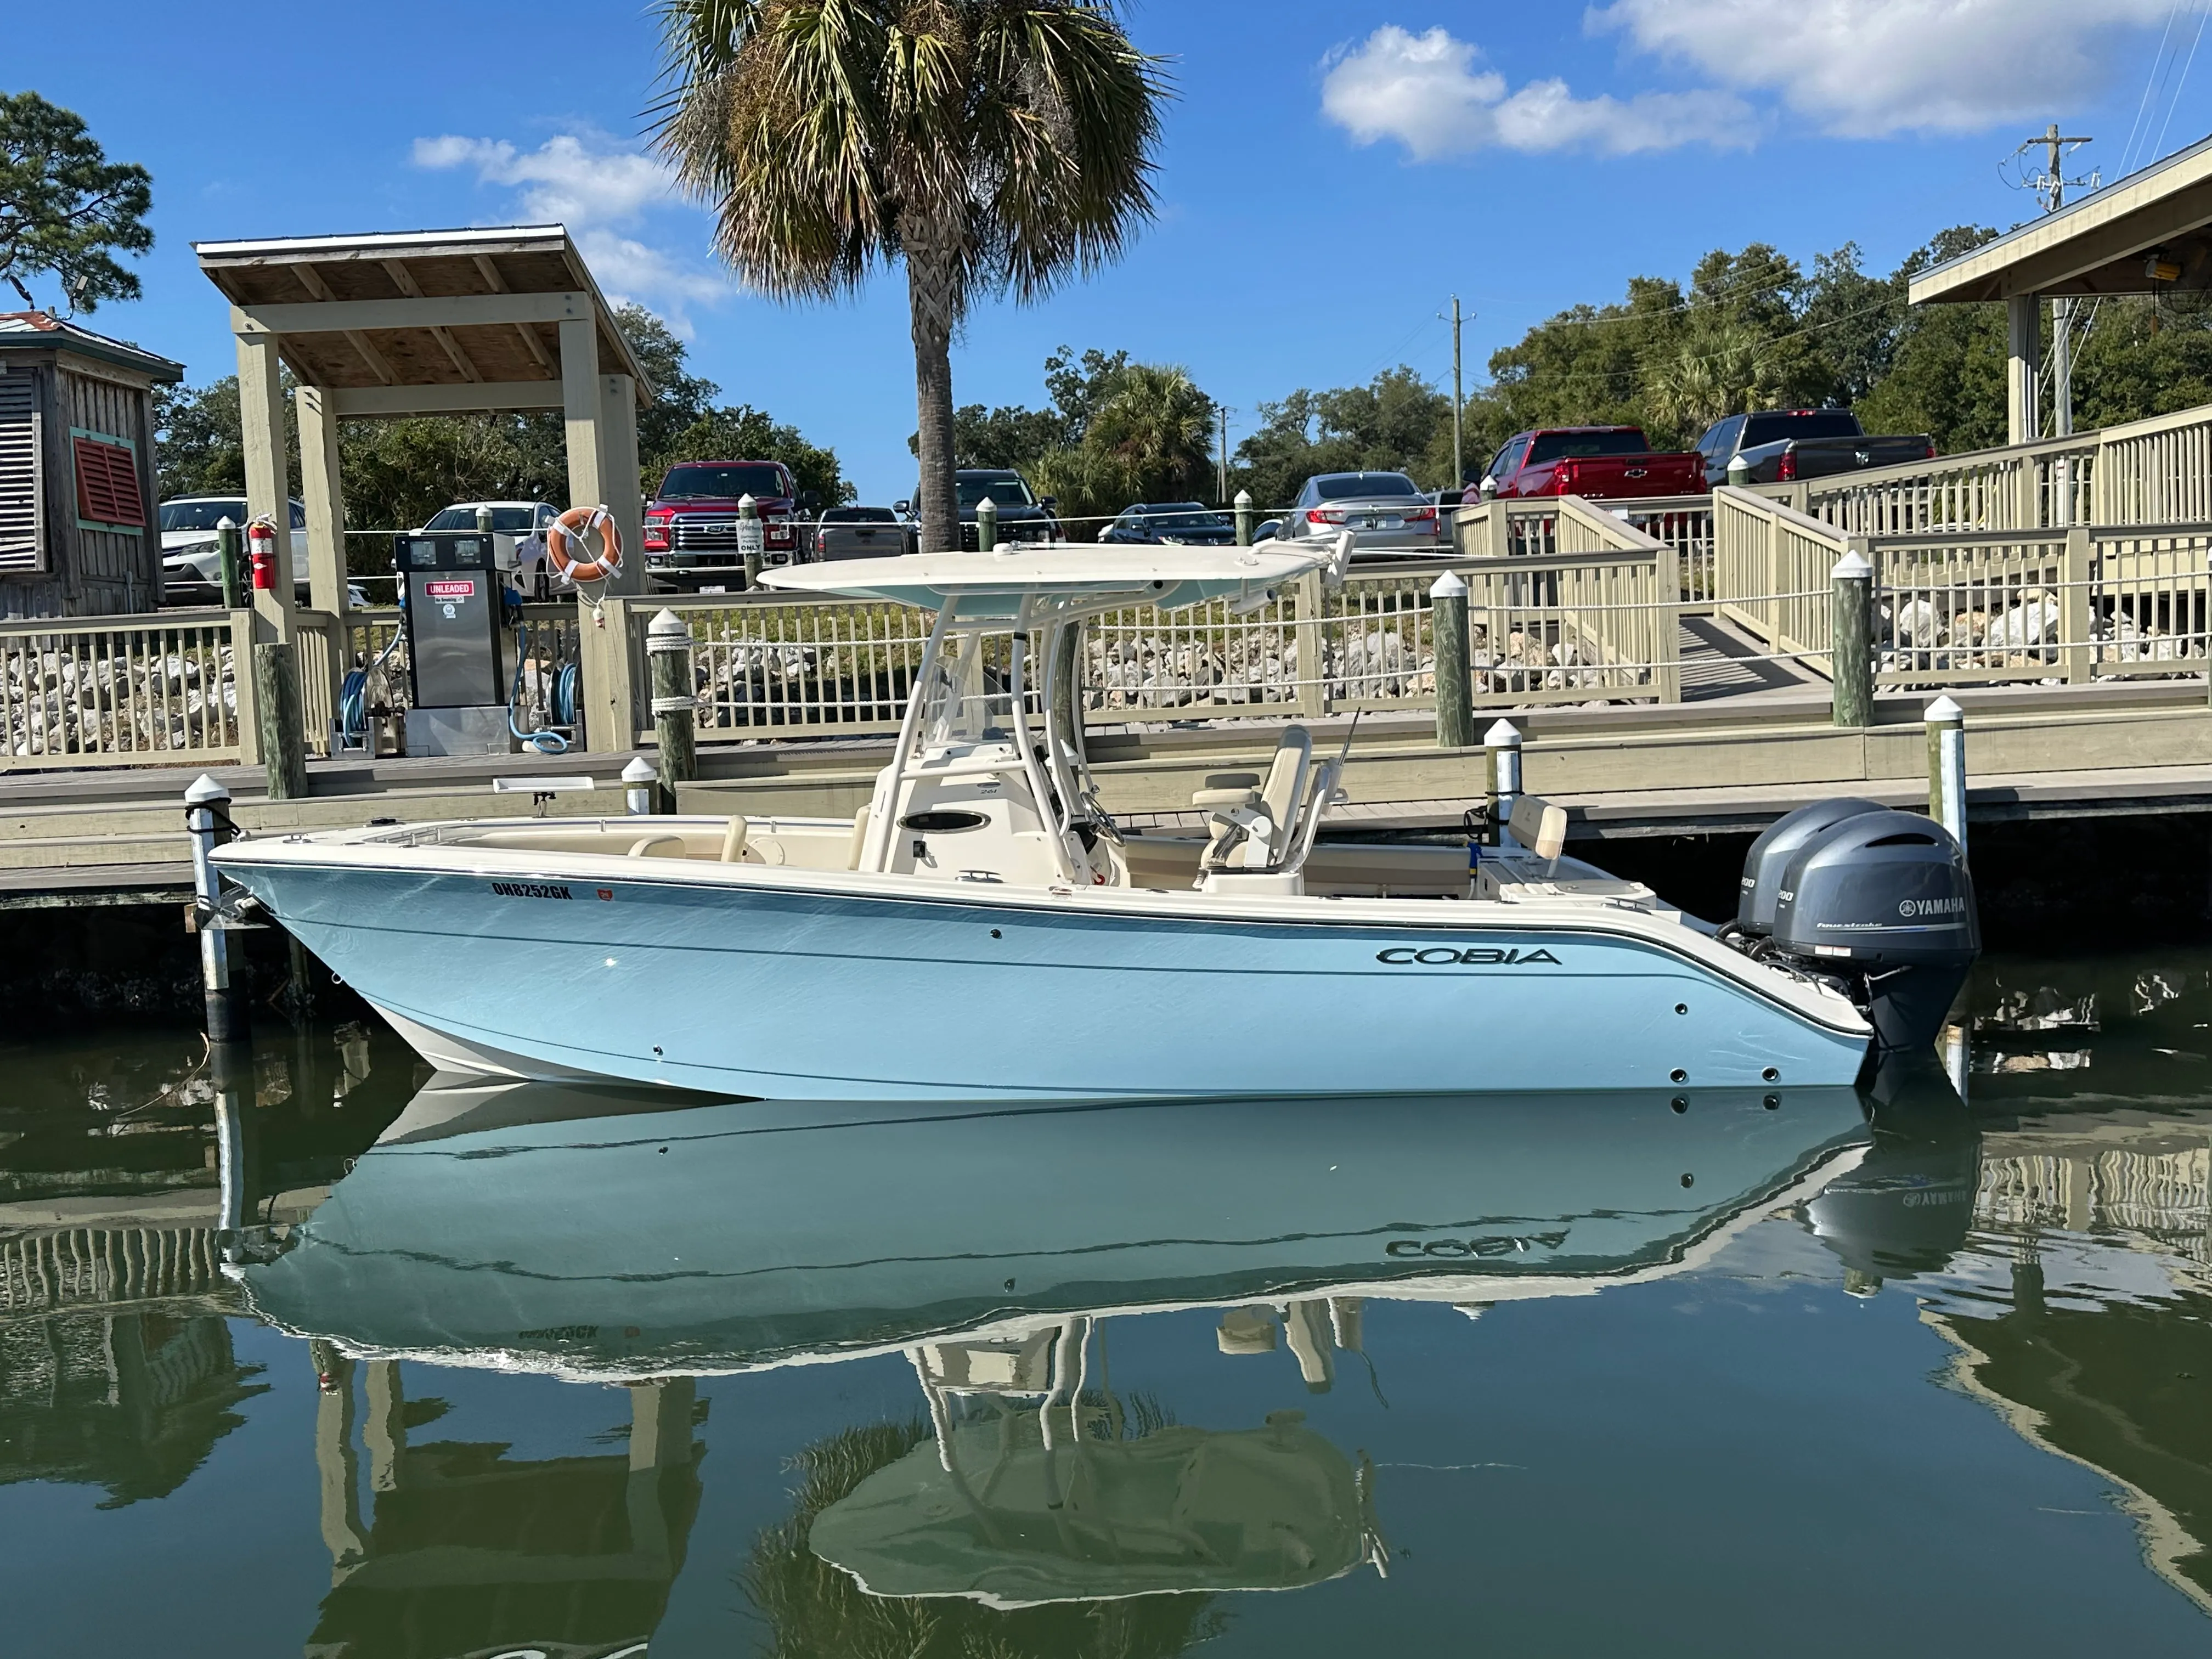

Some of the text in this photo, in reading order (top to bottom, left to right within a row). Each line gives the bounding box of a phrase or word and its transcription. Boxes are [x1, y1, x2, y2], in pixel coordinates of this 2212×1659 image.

[430, 584, 470, 593] UNLEADED
[492, 882, 573, 900] OH8252GK
[1916, 897, 1965, 915] YAMAHA
[1376, 948, 1562, 965] COBIA
